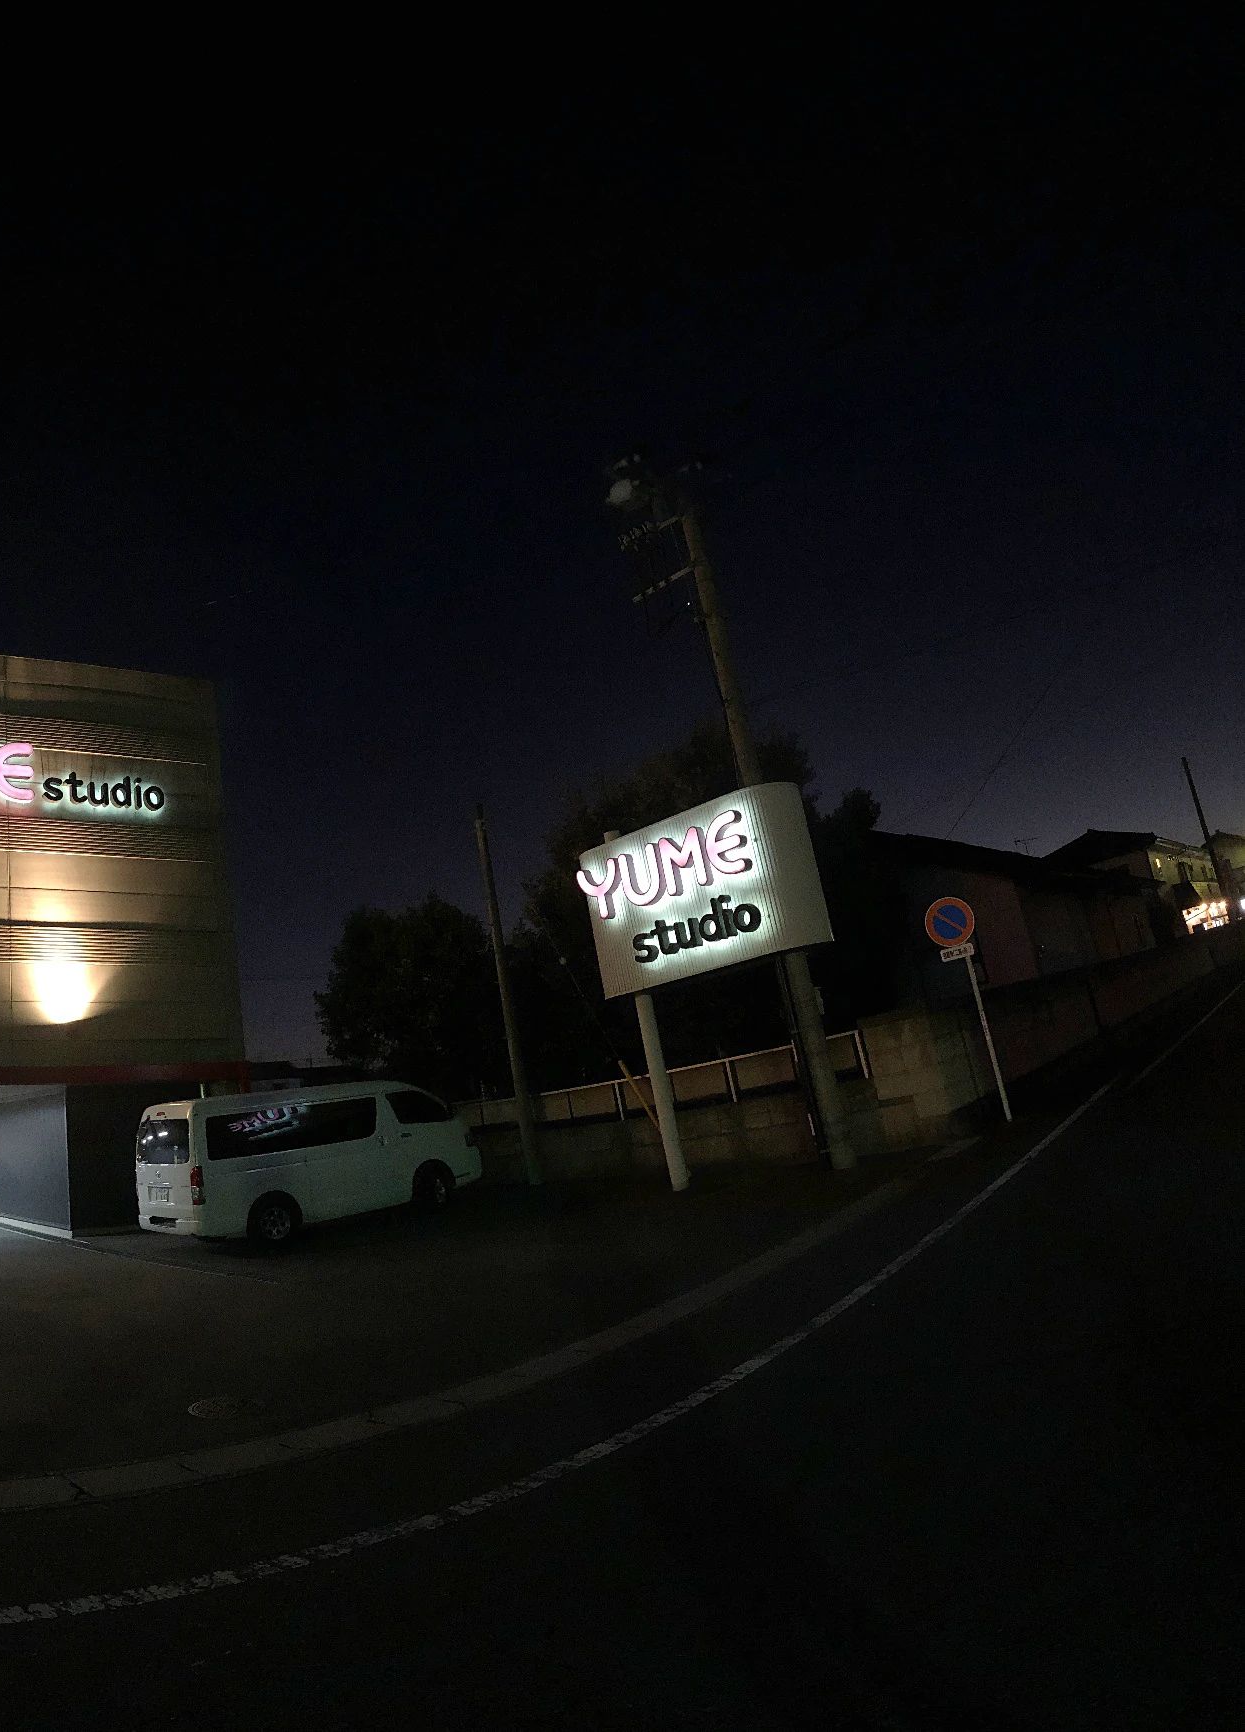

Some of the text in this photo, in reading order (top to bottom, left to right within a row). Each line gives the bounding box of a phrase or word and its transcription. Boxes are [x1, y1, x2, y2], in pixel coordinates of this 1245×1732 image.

[42, 771, 165, 812] studio
[576, 809, 753, 919] YUME
[632, 895, 761, 964] studio
